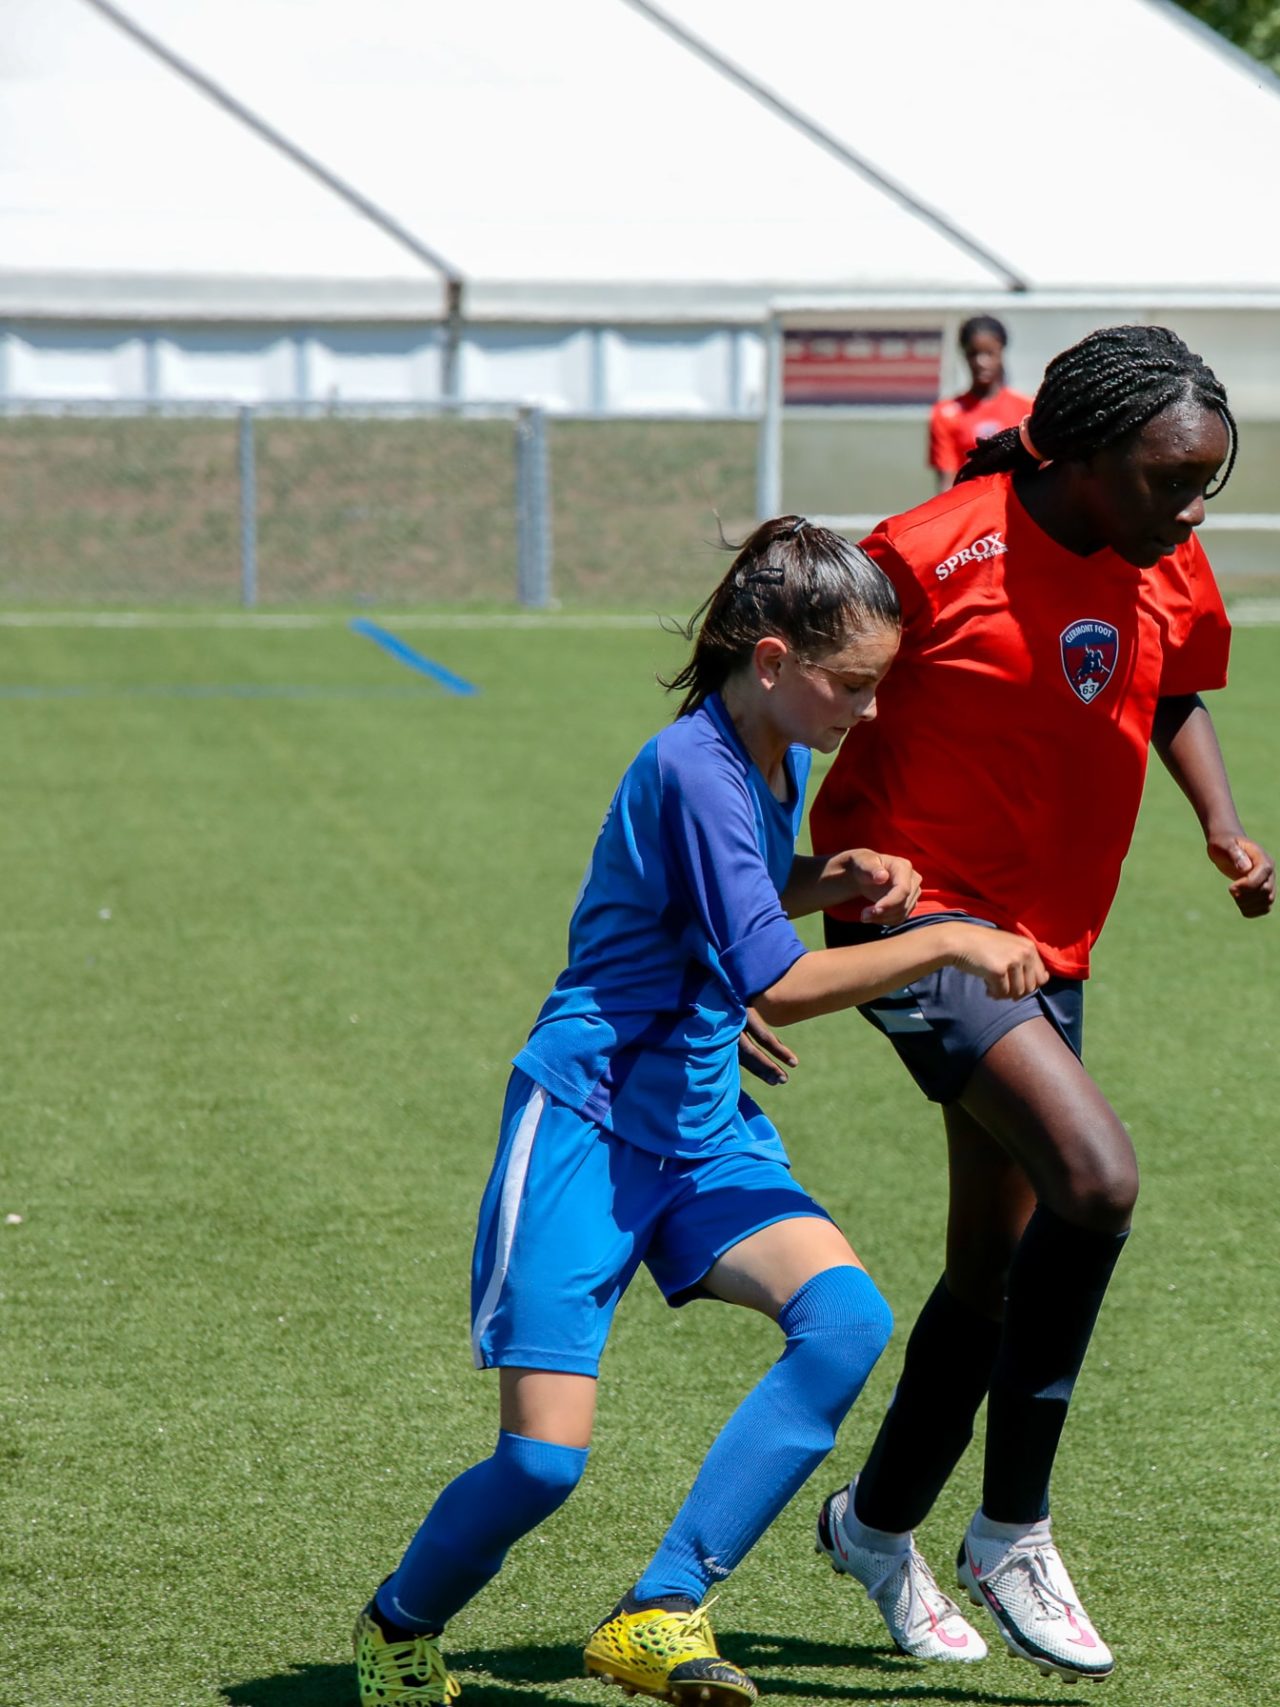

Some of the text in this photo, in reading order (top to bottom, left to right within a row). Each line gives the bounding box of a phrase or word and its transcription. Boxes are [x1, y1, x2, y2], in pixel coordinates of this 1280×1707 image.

[935, 532, 1007, 581] SPROX
[1065, 624, 1113, 643] CLERMONT FOOT
[1082, 684, 1095, 695] 63
